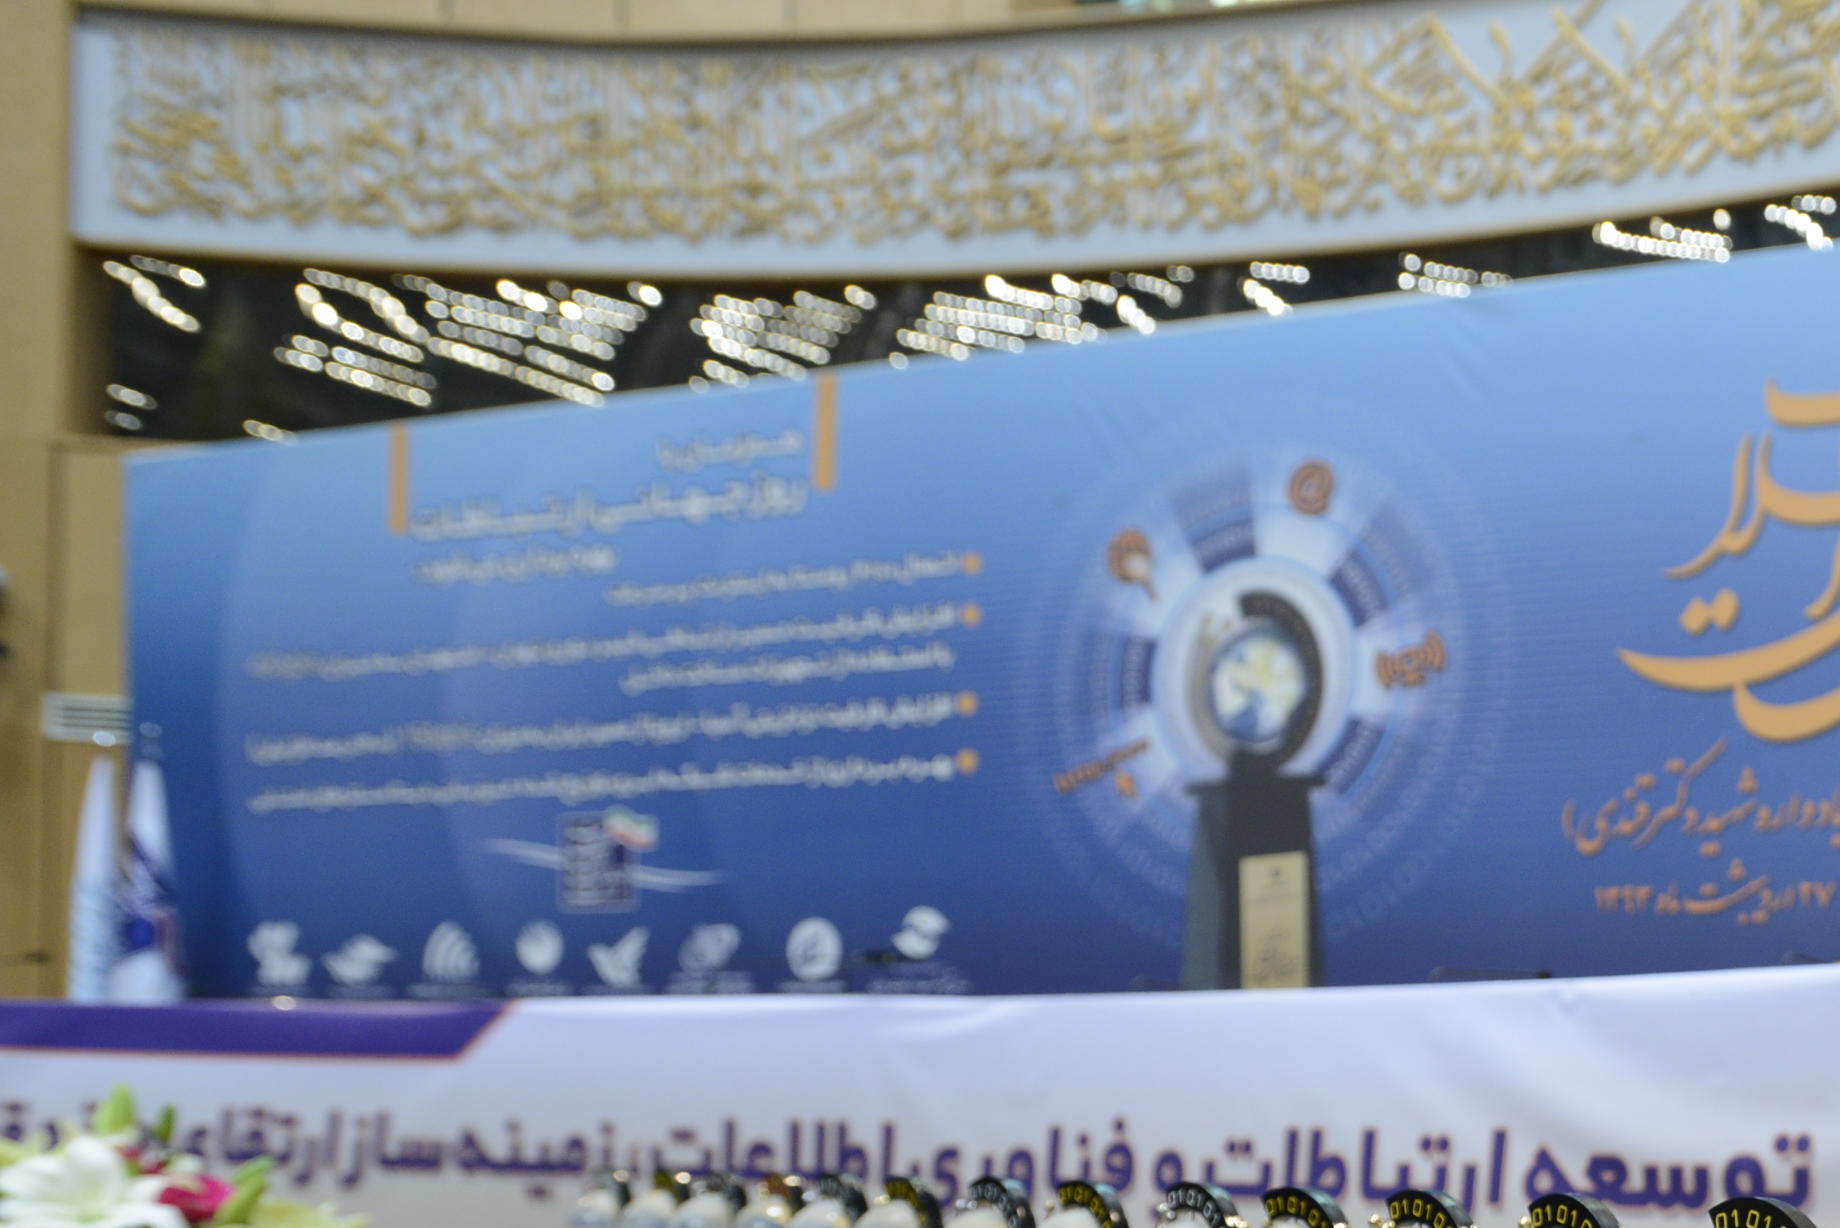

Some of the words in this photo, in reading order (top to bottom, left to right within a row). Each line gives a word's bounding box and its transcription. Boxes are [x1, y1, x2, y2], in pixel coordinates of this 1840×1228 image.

[909, 1117, 1134, 1207] فناوری
[1203, 1126, 1507, 1212] ارتباطات
[1524, 1133, 1812, 1209] توسعه
